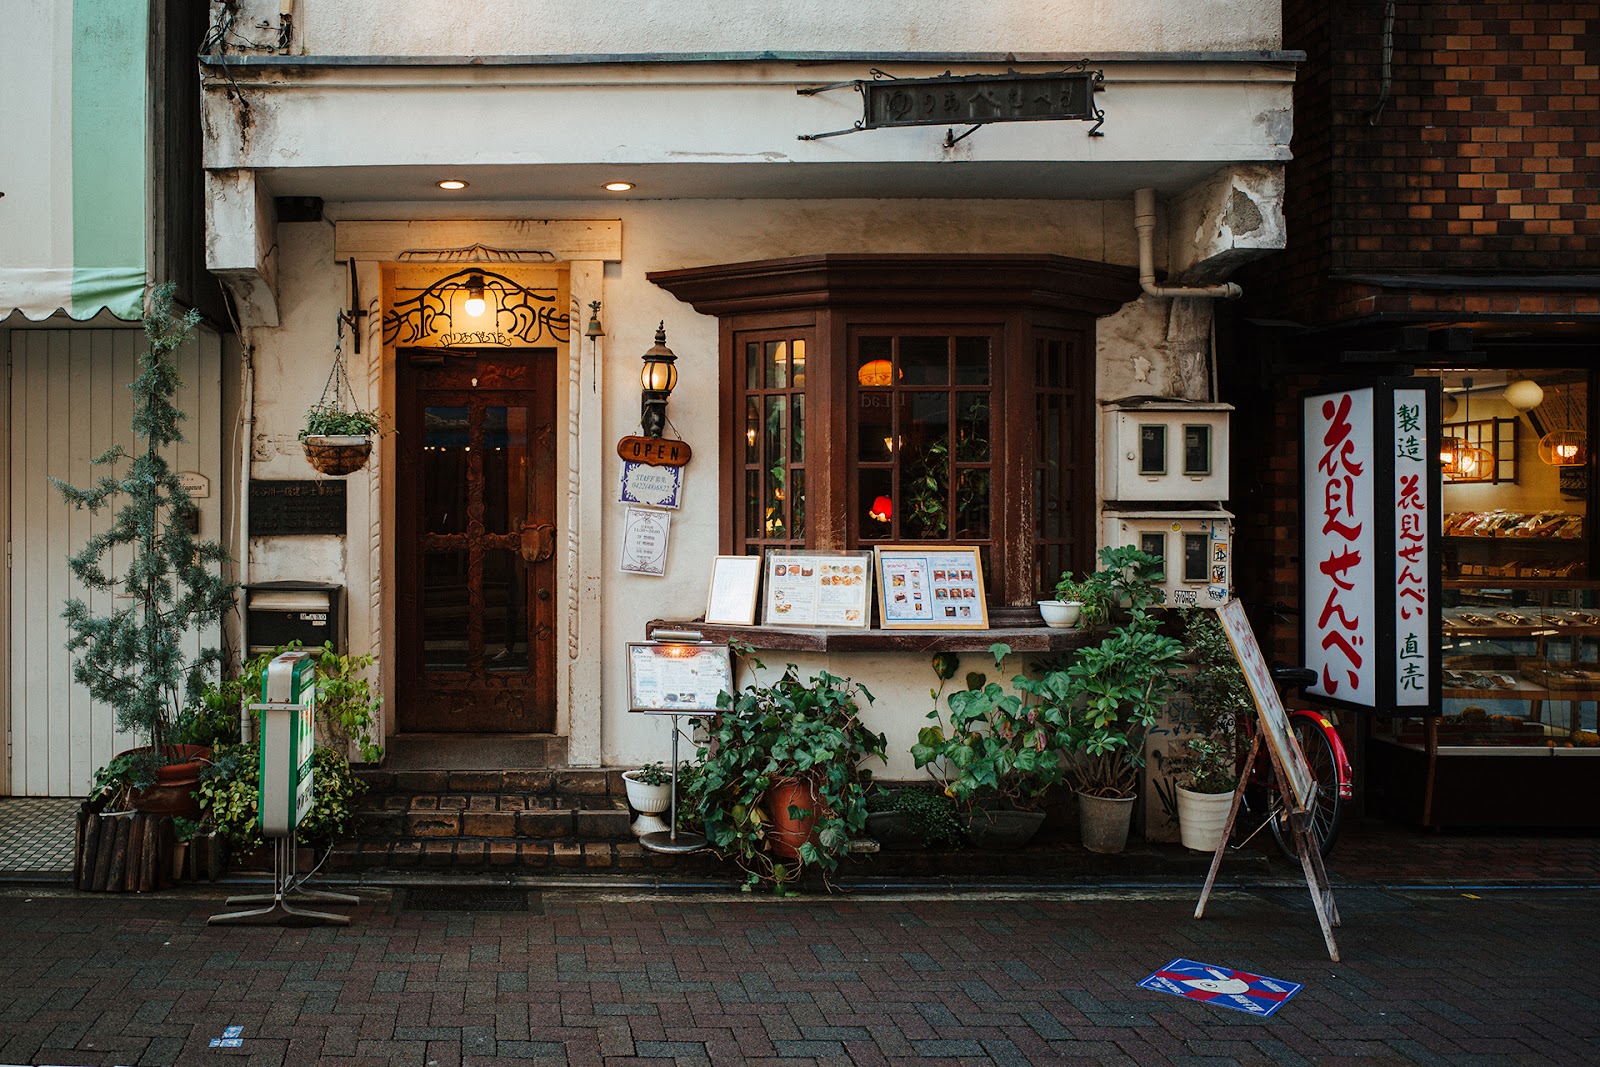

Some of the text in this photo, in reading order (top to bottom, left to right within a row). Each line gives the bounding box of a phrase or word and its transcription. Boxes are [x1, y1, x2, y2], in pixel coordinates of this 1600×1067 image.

[633, 442, 679, 461] OPEN
[635, 474, 655, 482] STAFF
[1318, 394, 1363, 695] 花見せんべい
[1397, 404, 1425, 690] 製造 花見せんべい 直売
